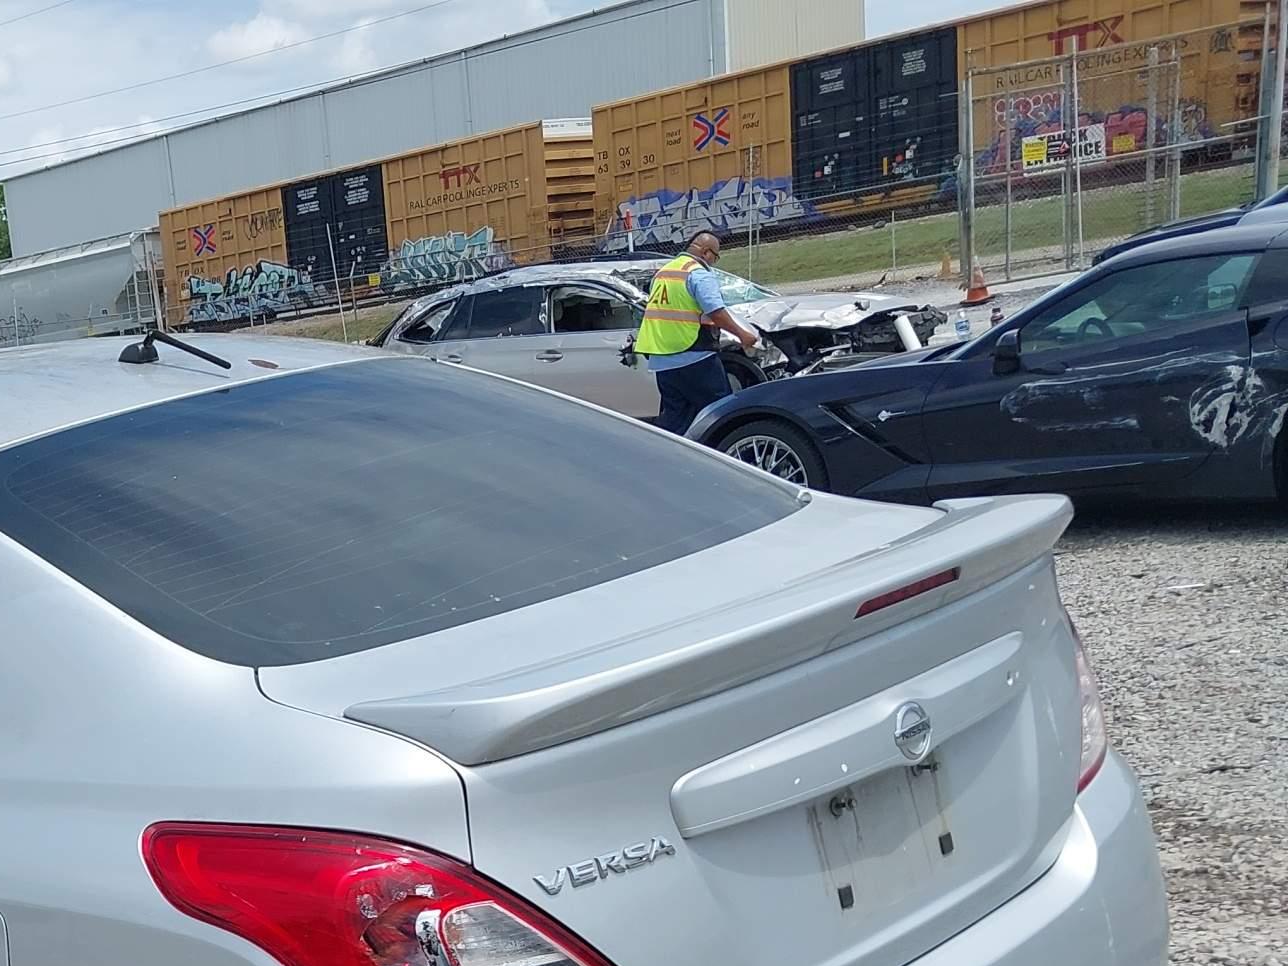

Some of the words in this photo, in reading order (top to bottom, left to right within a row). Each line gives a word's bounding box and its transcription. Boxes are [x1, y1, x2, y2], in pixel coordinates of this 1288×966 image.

[1047, 16, 1125, 56] TTX
[742, 119, 760, 130] road
[666, 129, 681, 138] next
[666, 137, 682, 146] load
[598, 151, 608, 160] TB
[618, 146, 631, 156] OX
[597, 163, 609, 174] 63
[619, 159, 631, 169] 39
[642, 154, 655, 165] 30
[439, 165, 481, 190] TTX
[531, 836, 677, 897] VERSA
